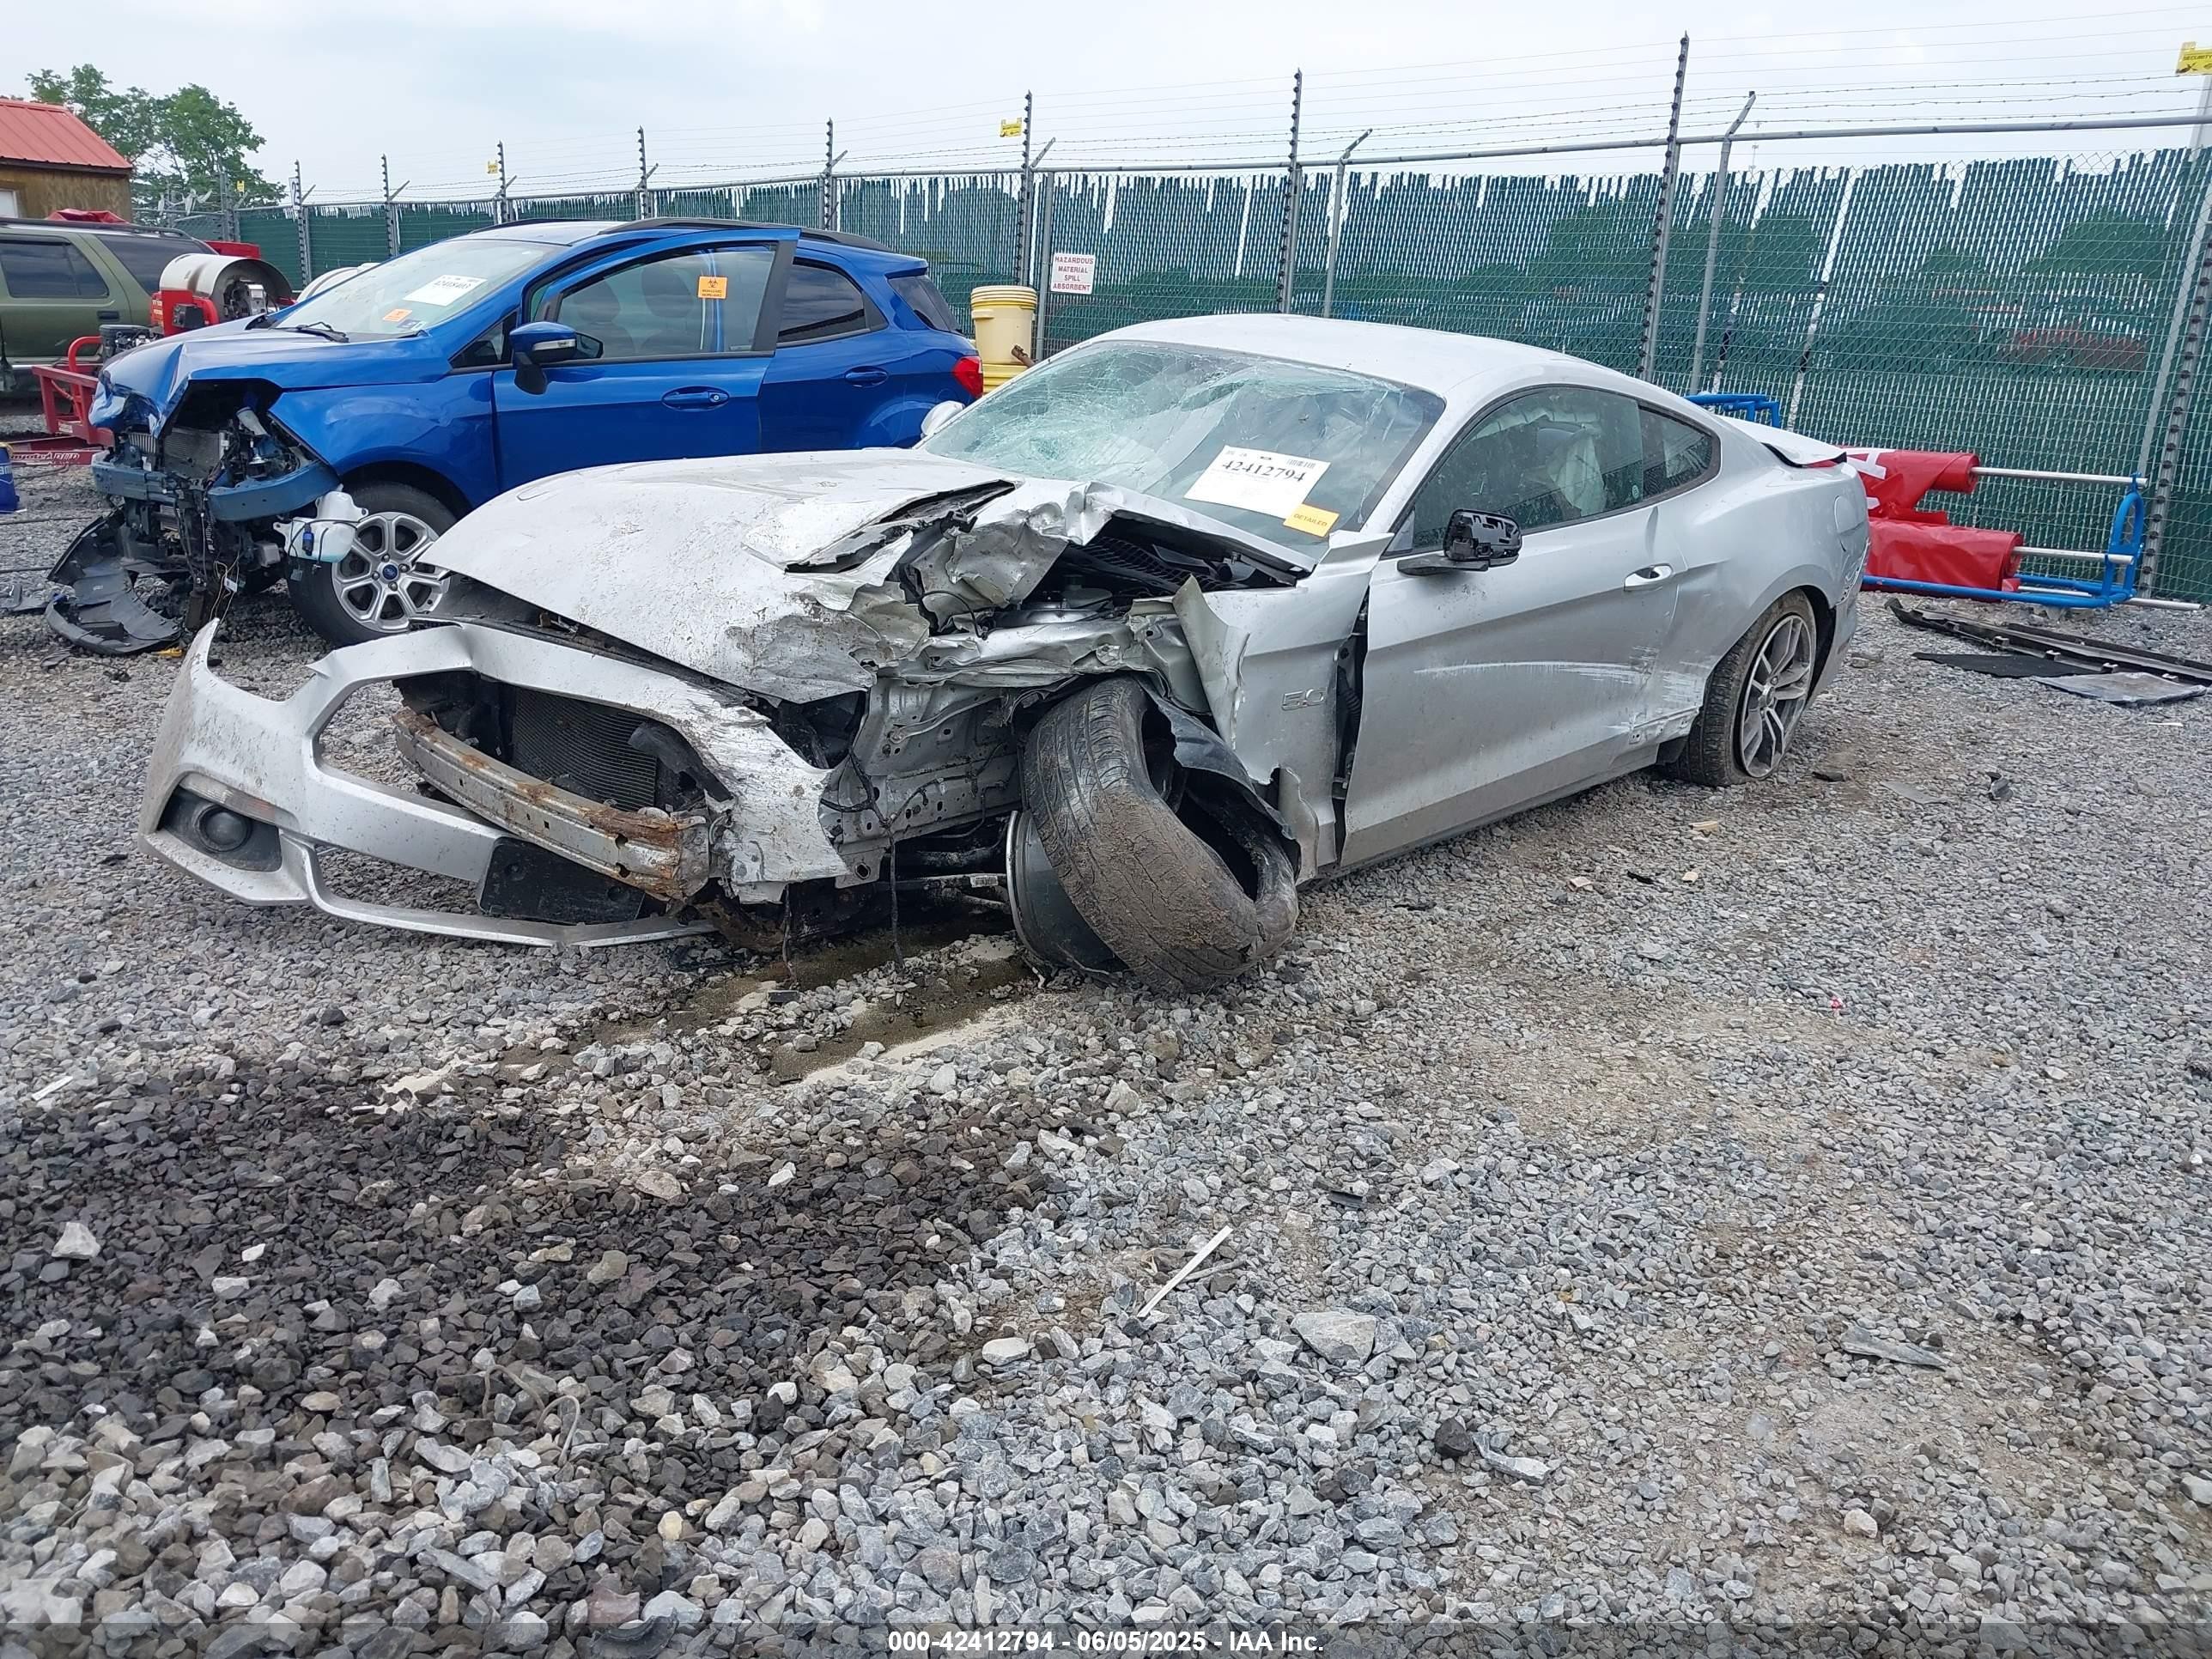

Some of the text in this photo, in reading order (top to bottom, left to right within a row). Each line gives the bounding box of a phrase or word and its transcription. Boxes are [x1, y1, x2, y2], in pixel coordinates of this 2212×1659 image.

[1054, 256, 1094, 264] HAZARDOUS
[1058, 265, 1088, 274] MATERIAL
[1053, 283, 1091, 292] ABSORBENT
[1222, 459, 1306, 482] 42412794
[1293, 514, 1328, 527] DETAILED
[1281, 687, 1328, 711] 5.0
